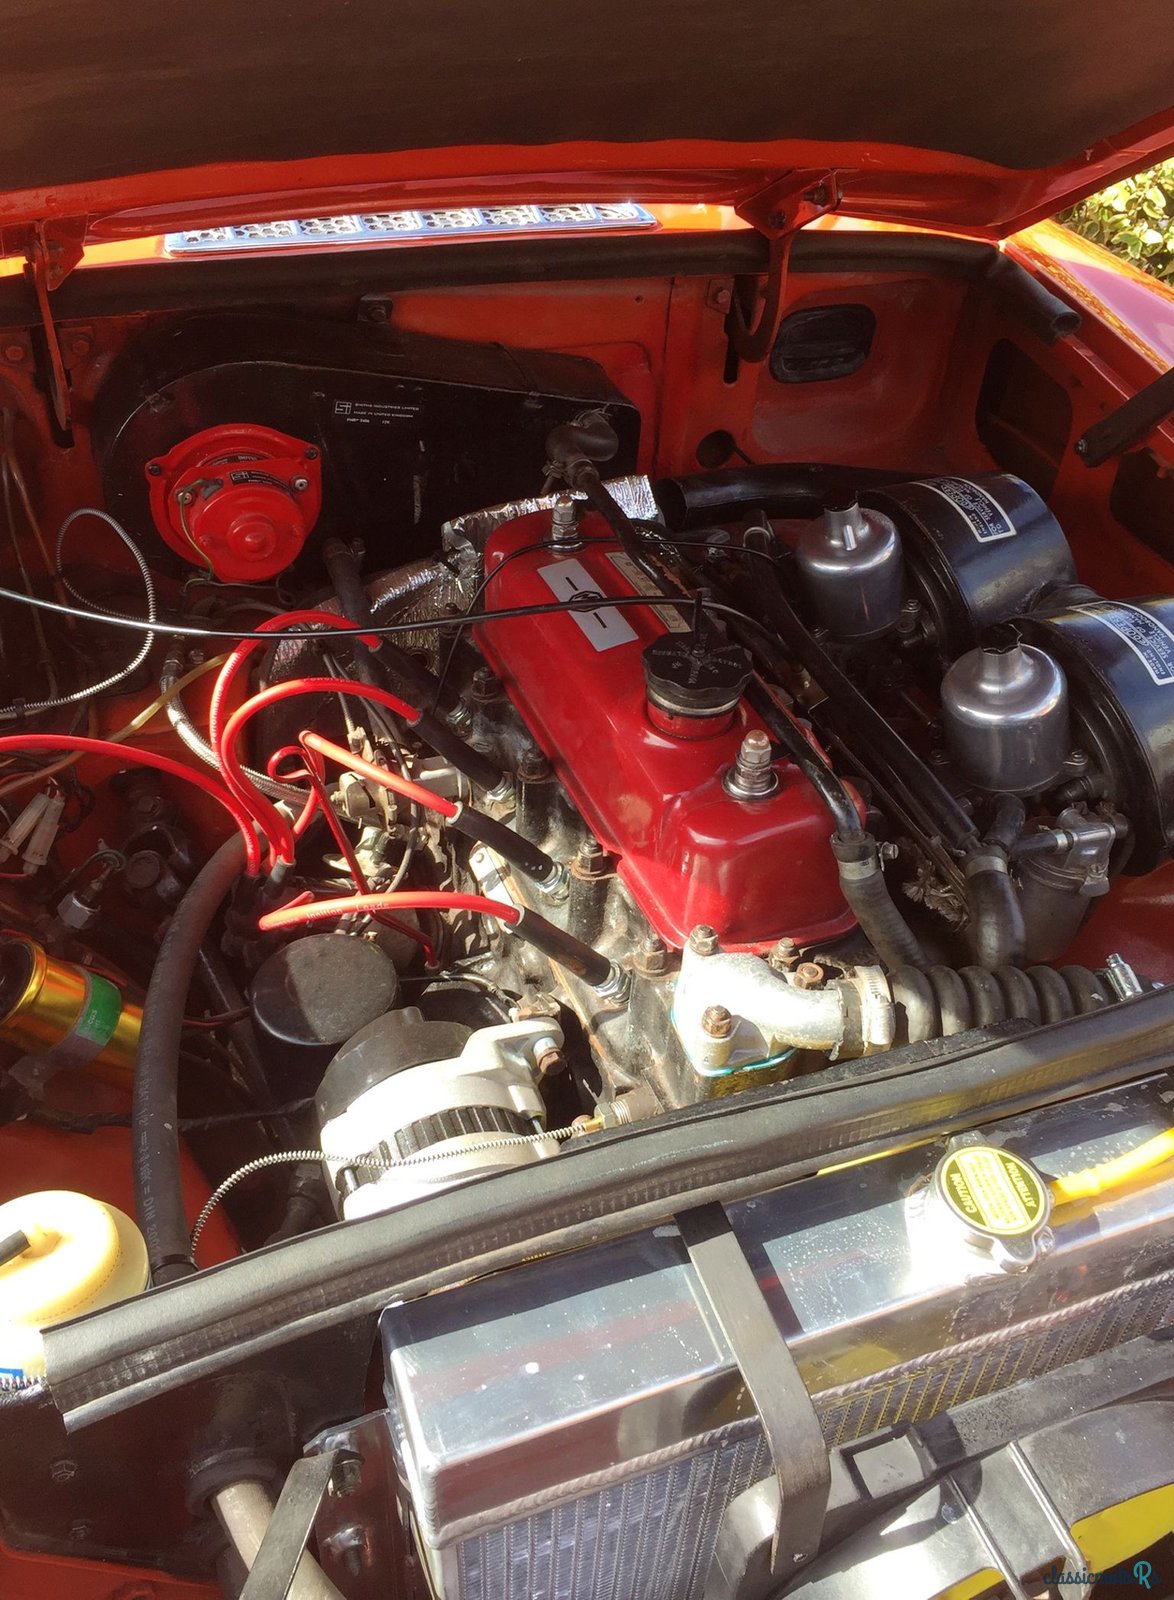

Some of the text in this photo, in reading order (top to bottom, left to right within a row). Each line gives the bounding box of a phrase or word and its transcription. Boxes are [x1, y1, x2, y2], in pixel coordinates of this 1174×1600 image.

[1145, 648, 1166, 675] ENGLAND
[1146, 634, 1170, 659] SERVICE
[949, 1172, 978, 1214] CAUTION
[1004, 1162, 1037, 1208] ATTENTION
